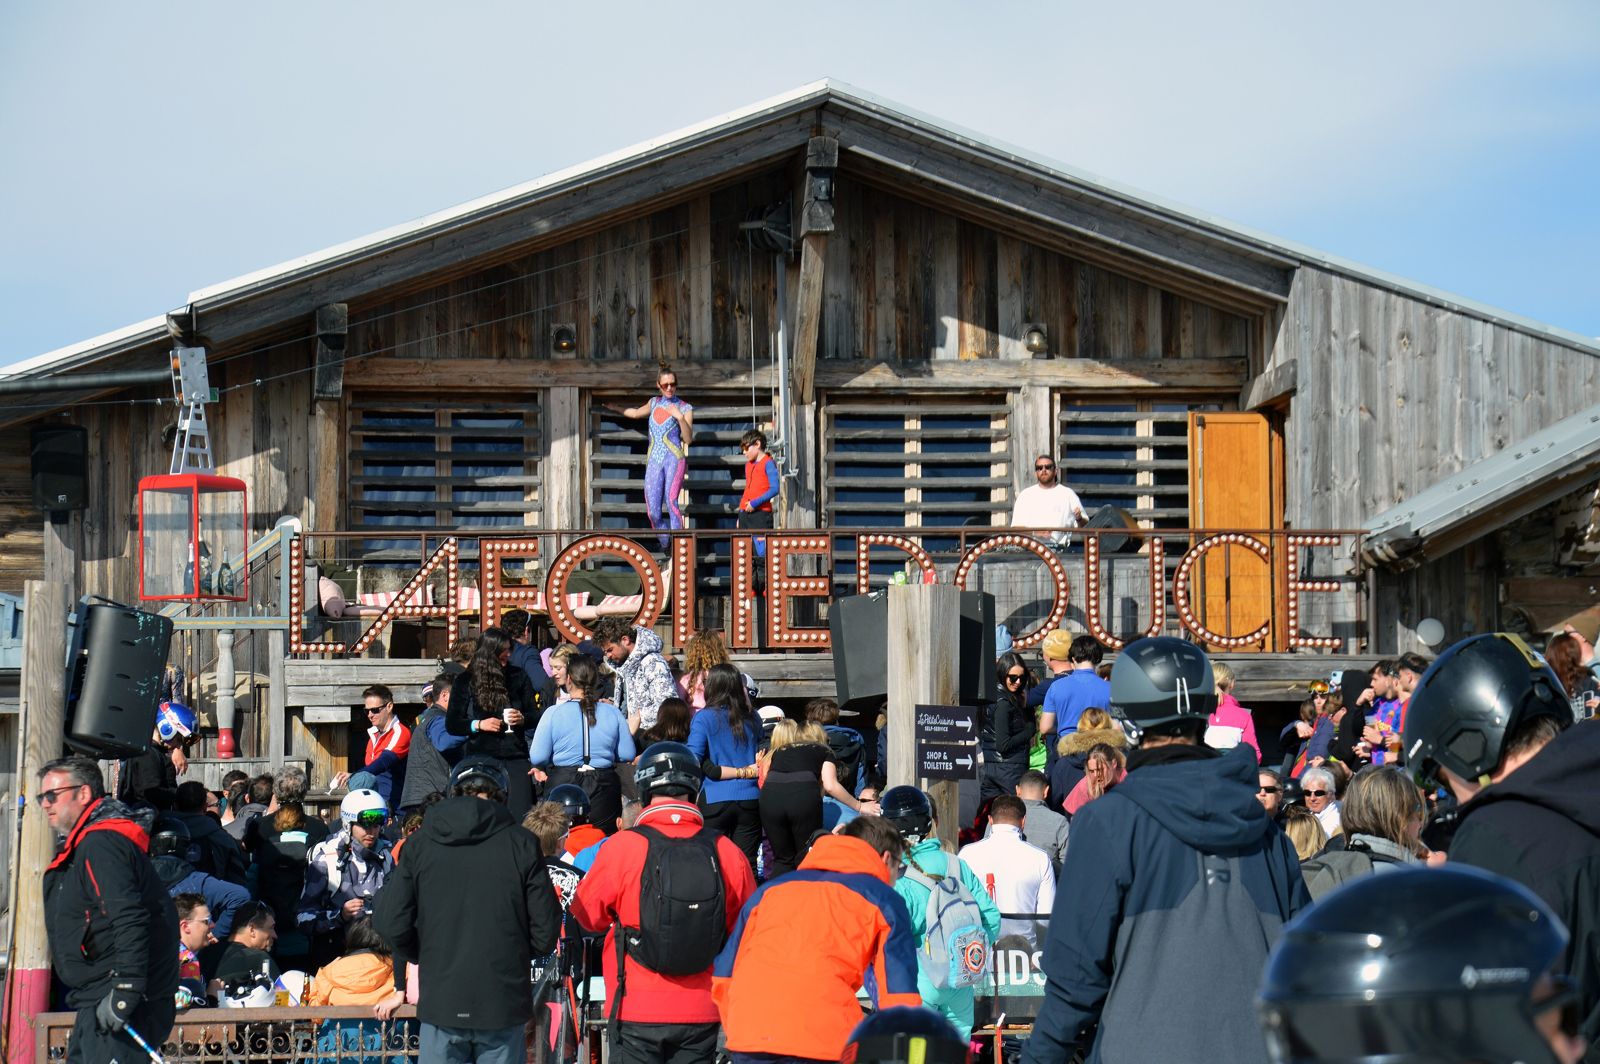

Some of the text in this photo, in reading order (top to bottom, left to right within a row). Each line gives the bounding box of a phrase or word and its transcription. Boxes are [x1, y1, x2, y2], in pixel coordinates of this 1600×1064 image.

[290, 535, 459, 653] LA
[478, 533, 832, 649] FOLIE
[926, 751, 948, 760] SHOP &
[923, 761, 953, 770] TOILETTES
